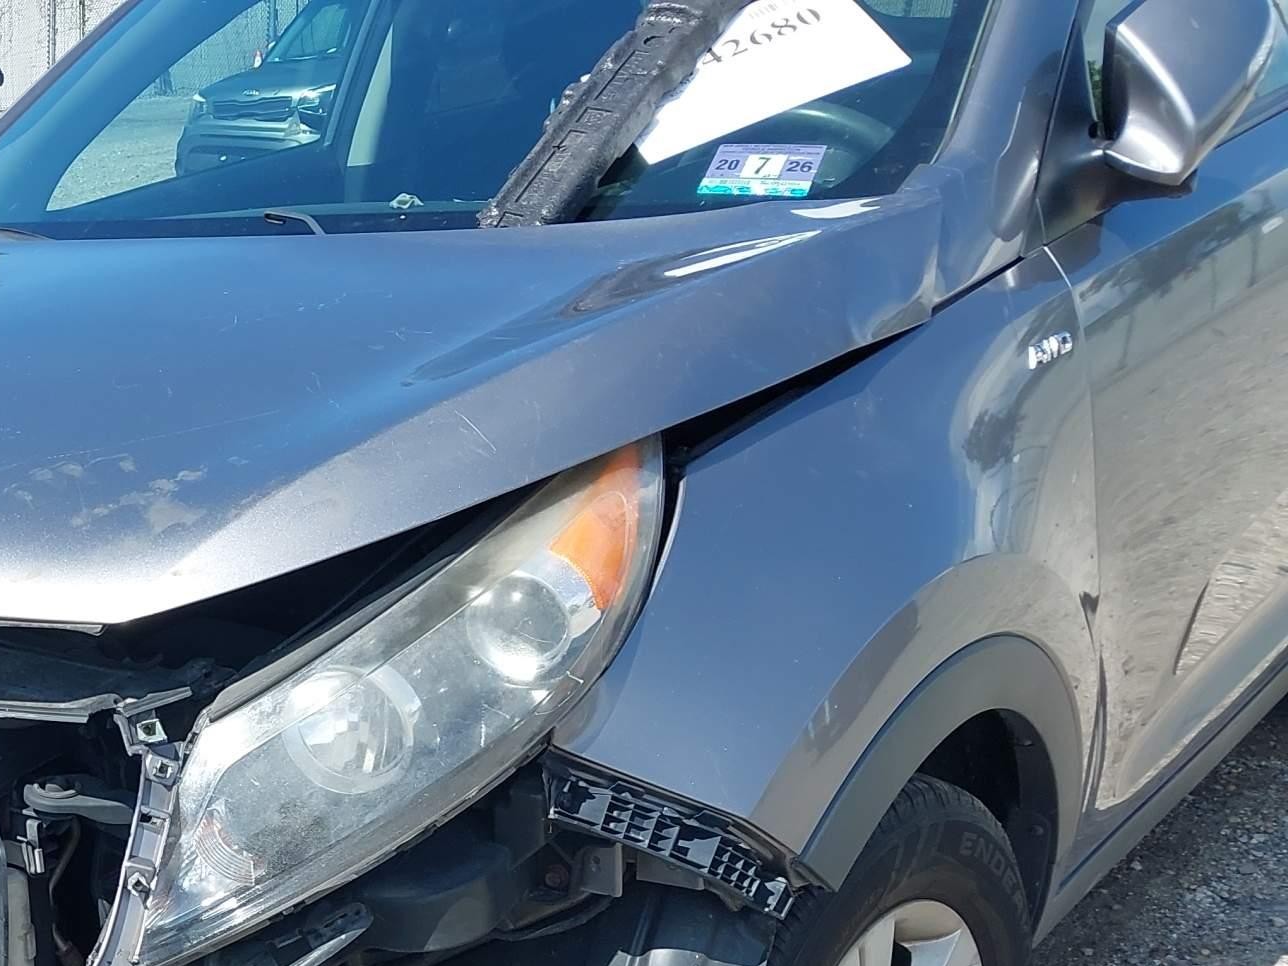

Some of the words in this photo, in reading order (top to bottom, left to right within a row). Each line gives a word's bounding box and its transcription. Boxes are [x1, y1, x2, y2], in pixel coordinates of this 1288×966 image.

[715, 159, 741, 171] 20
[754, 156, 772, 175] 7
[786, 160, 813, 173] 26
